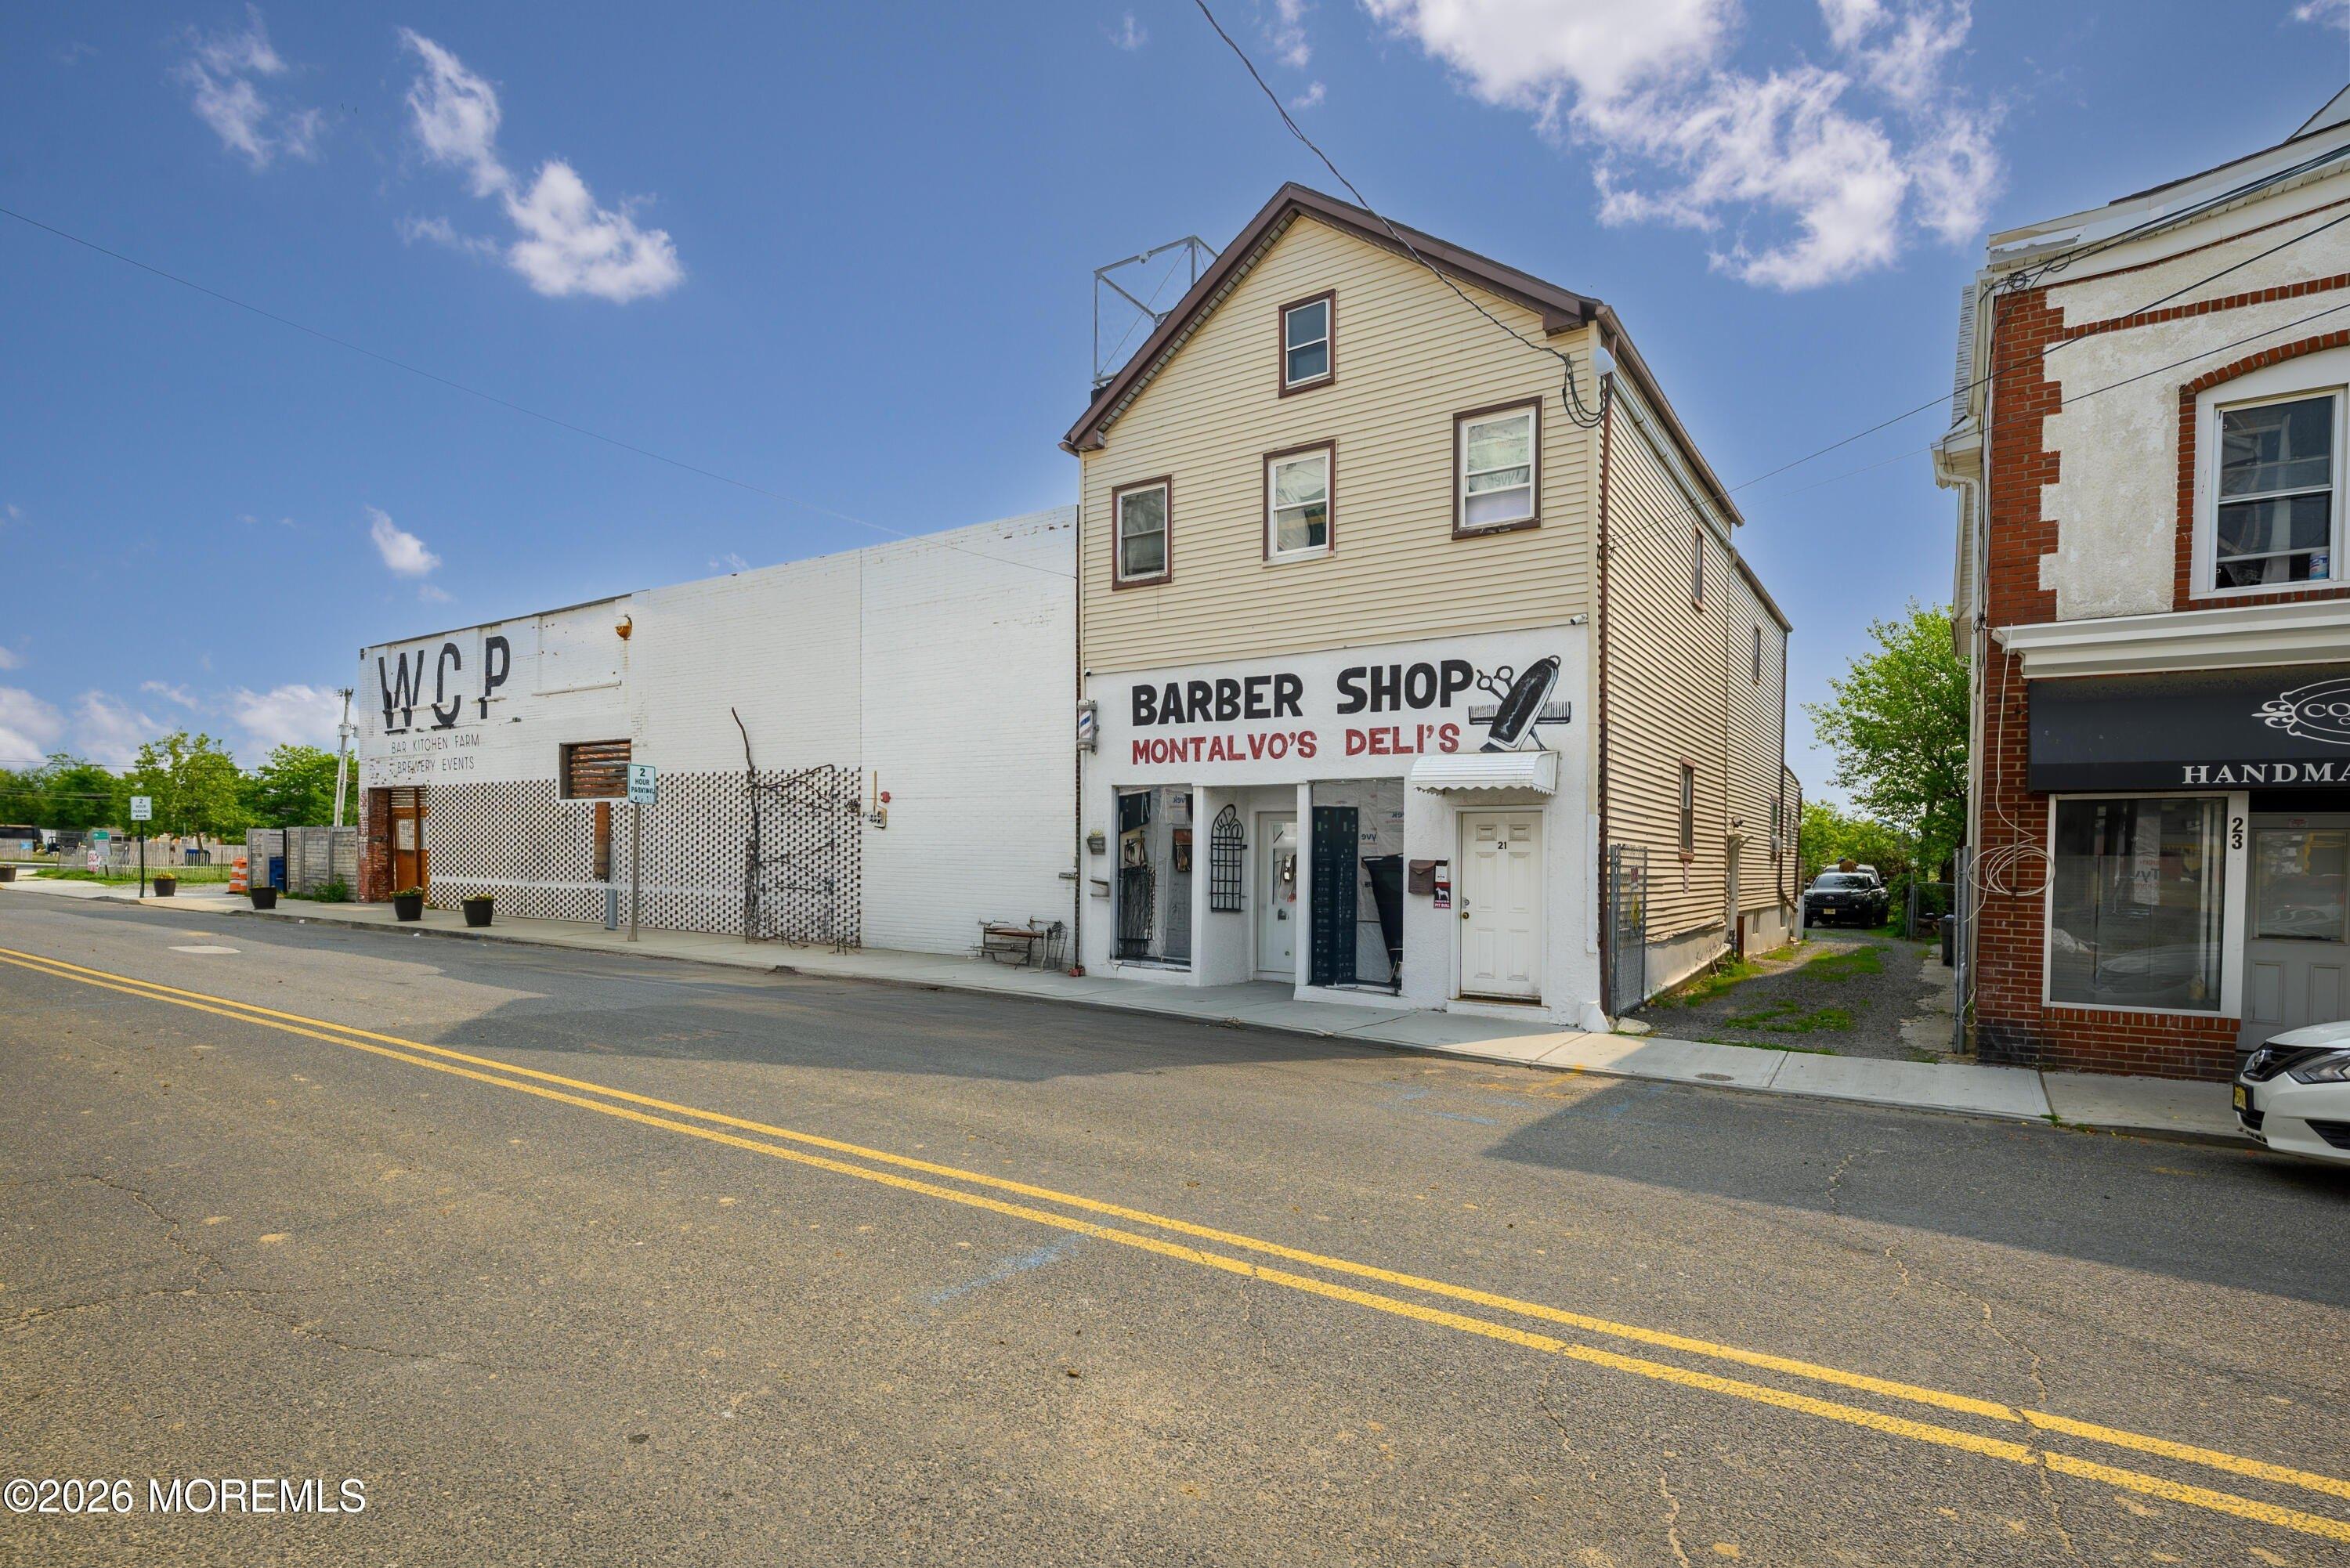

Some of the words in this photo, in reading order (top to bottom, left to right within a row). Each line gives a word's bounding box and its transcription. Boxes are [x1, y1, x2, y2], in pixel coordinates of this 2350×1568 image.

[378, 635, 510, 728] WCP
[1132, 673, 1303, 727] BARBER
[1336, 659, 1474, 715] SHOP
[392, 741, 407, 754] BAR
[413, 736, 448, 753] KITCHEN
[455, 733, 479, 749] FARM
[1132, 730, 1318, 765] MONTALVO'S
[1345, 722, 1461, 757] DELI'S
[397, 759, 436, 774] BREWERY
[442, 756, 475, 771] EVENTS
[639, 768, 646, 777] 2
[634, 778, 650, 786] HOUR
[2231, 817, 2243, 850] 23
[1498, 841, 1507, 850] 21
